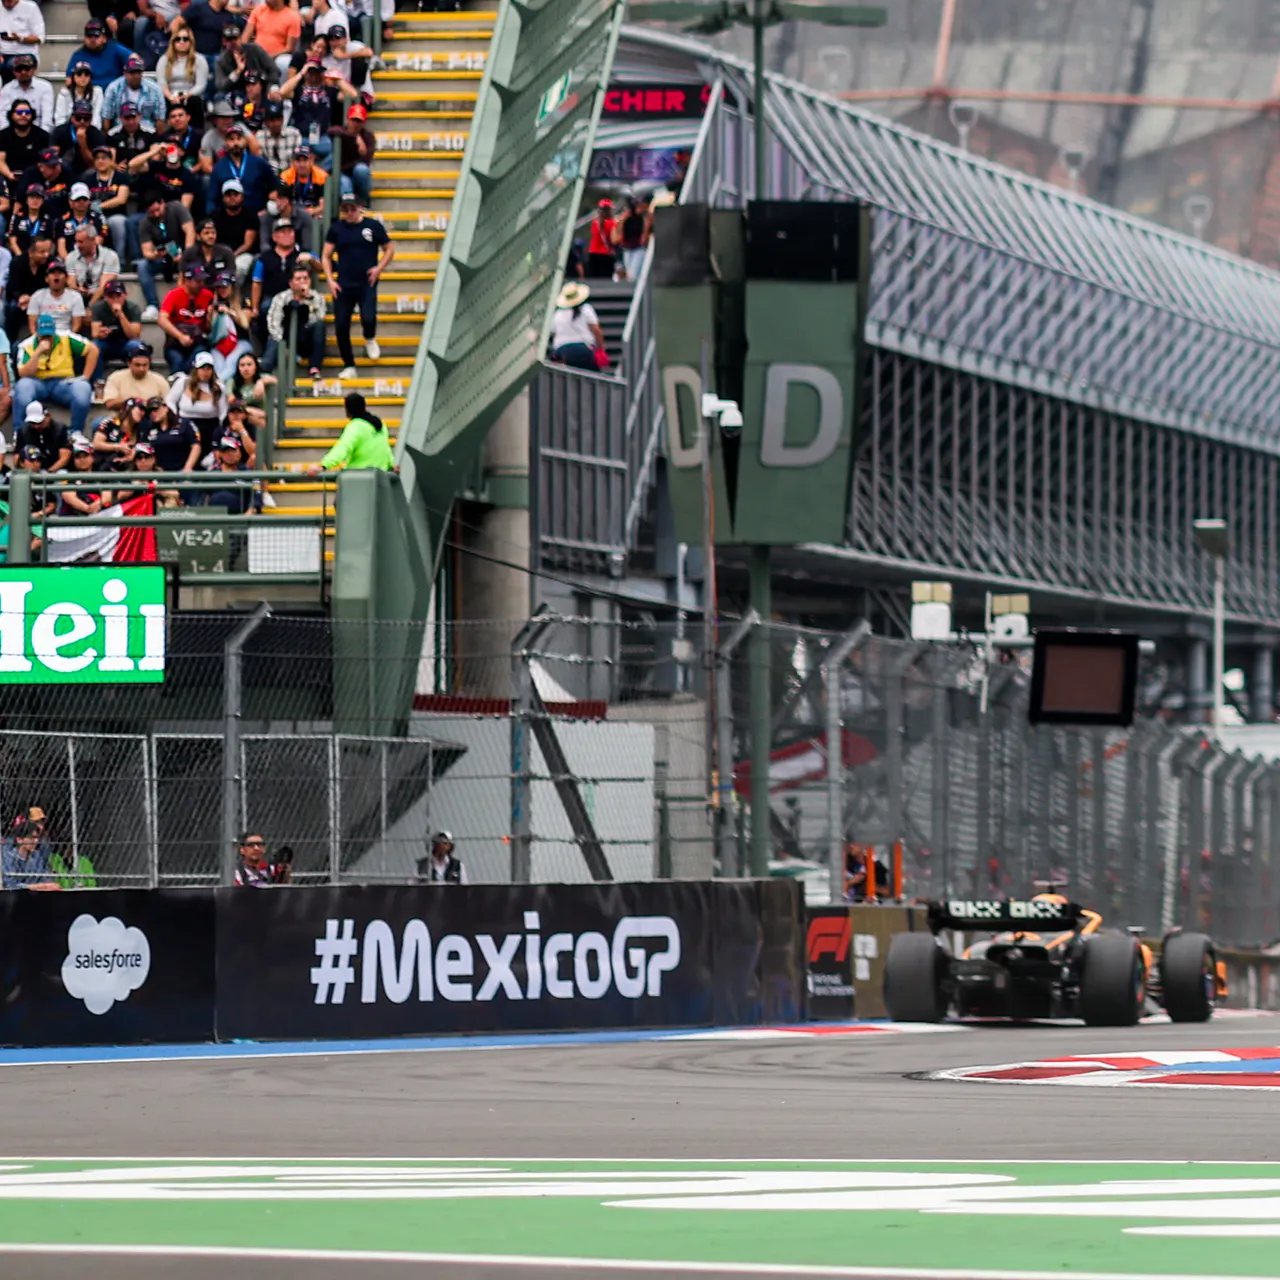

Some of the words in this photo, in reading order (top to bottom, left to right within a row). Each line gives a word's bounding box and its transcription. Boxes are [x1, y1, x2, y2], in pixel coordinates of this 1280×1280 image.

[759, 364, 844, 467] D
[172, 528, 224, 547] VE-24
[75, 948, 142, 974] salesforce
[311, 911, 681, 1004] #MexicoGP
